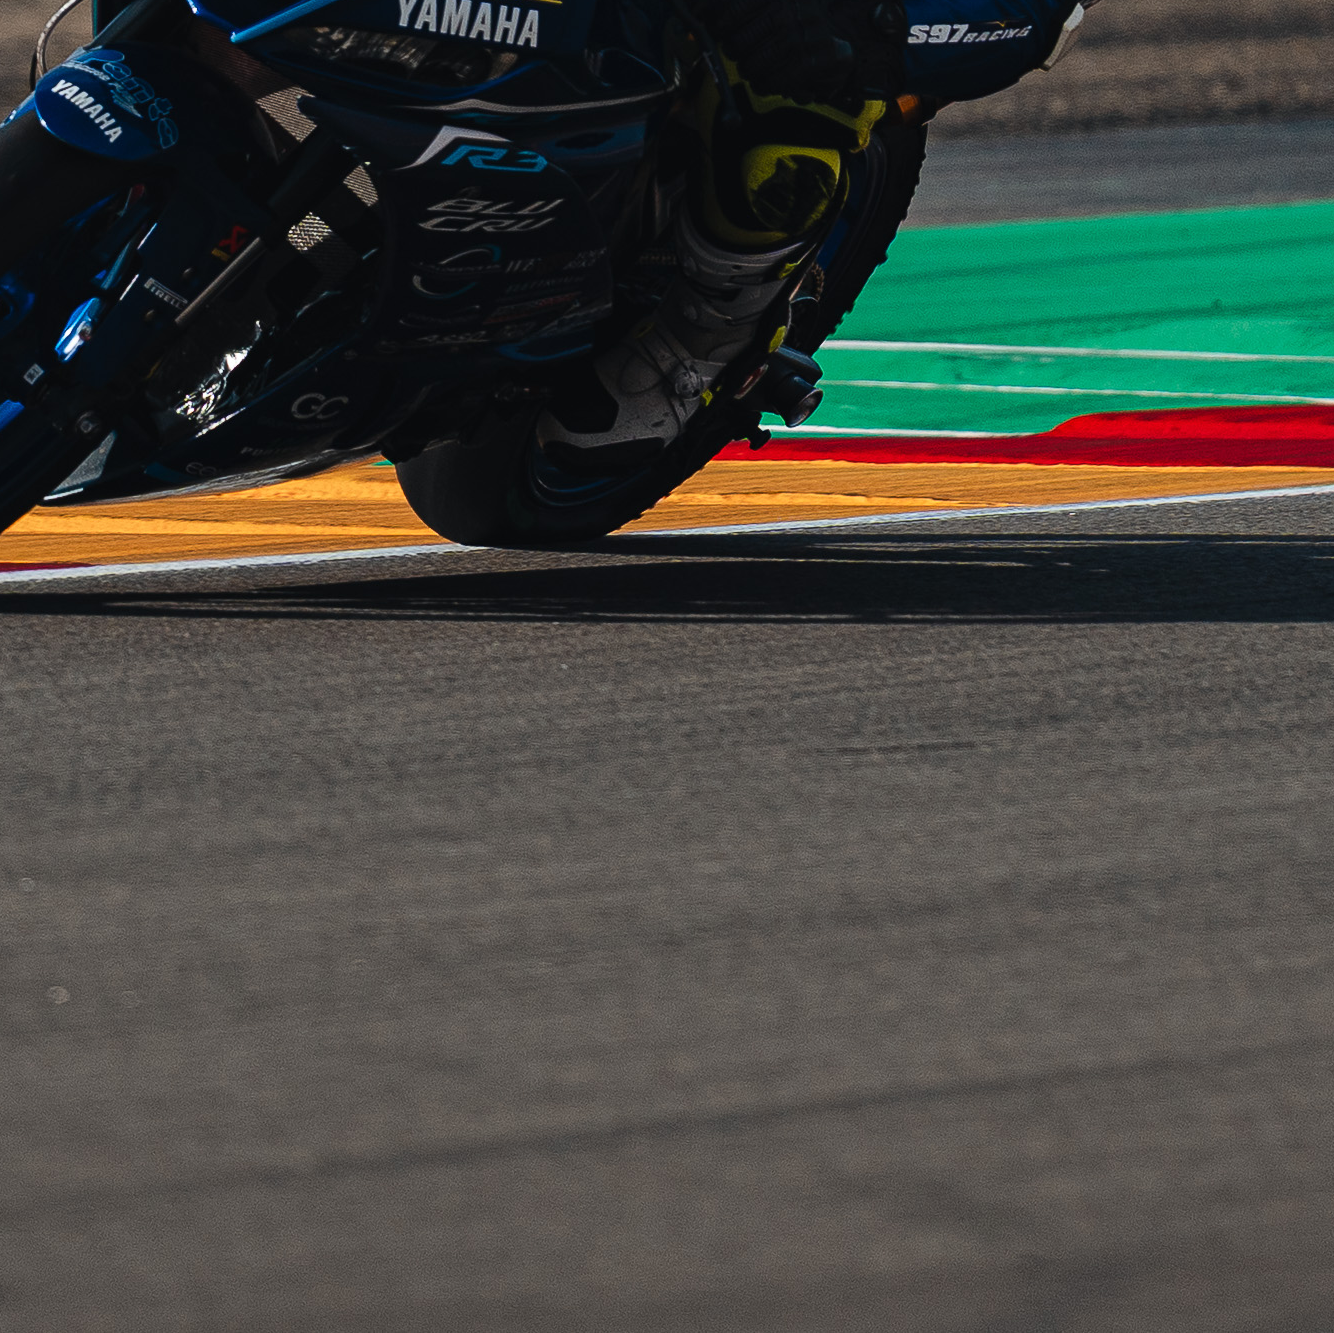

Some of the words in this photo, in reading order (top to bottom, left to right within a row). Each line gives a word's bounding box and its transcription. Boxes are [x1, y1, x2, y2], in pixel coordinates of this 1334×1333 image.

[907, 24, 970, 44] S97
[51, 79, 123, 143] YAMAHA
[426, 198, 565, 215] BLU
[417, 217, 557, 233] CRU
